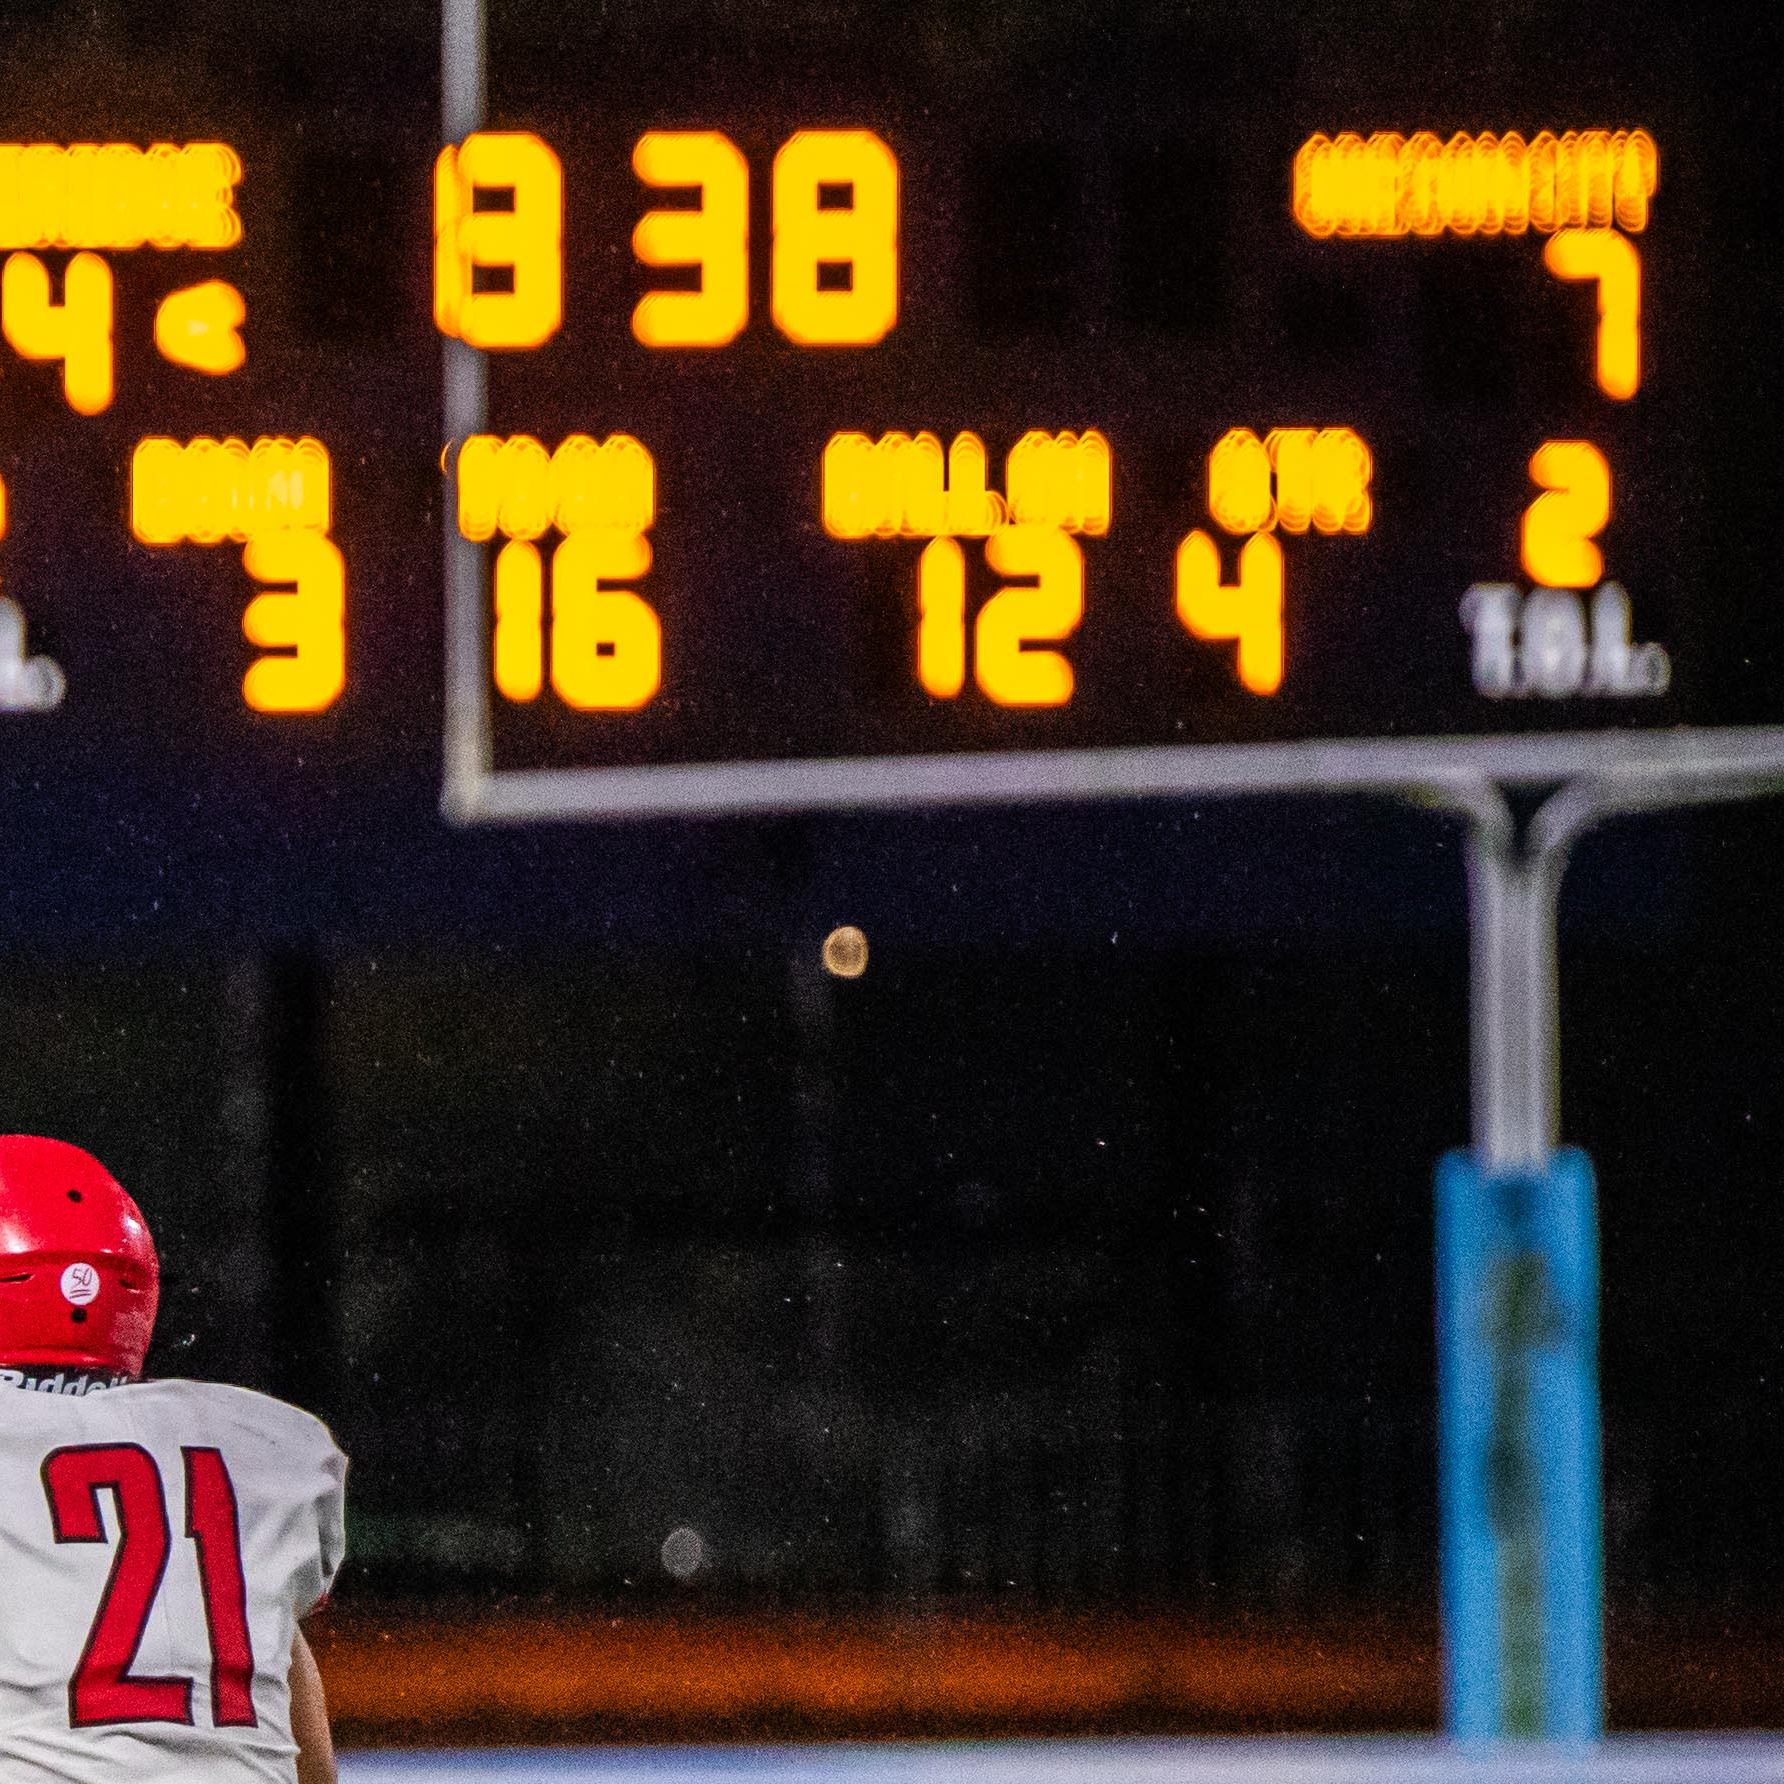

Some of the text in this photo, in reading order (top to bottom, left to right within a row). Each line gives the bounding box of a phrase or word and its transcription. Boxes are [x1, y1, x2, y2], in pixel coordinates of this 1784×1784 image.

[632, 129, 900, 348] 38
[1543, 228, 1641, 400] 7
[1520, 440, 1613, 589] 2
[242, 527, 346, 713] 3
[494, 527, 662, 711] 16
[917, 523, 1085, 708] 12
[1174, 530, 1285, 697] 4
[39, 1442, 259, 1728] 21
